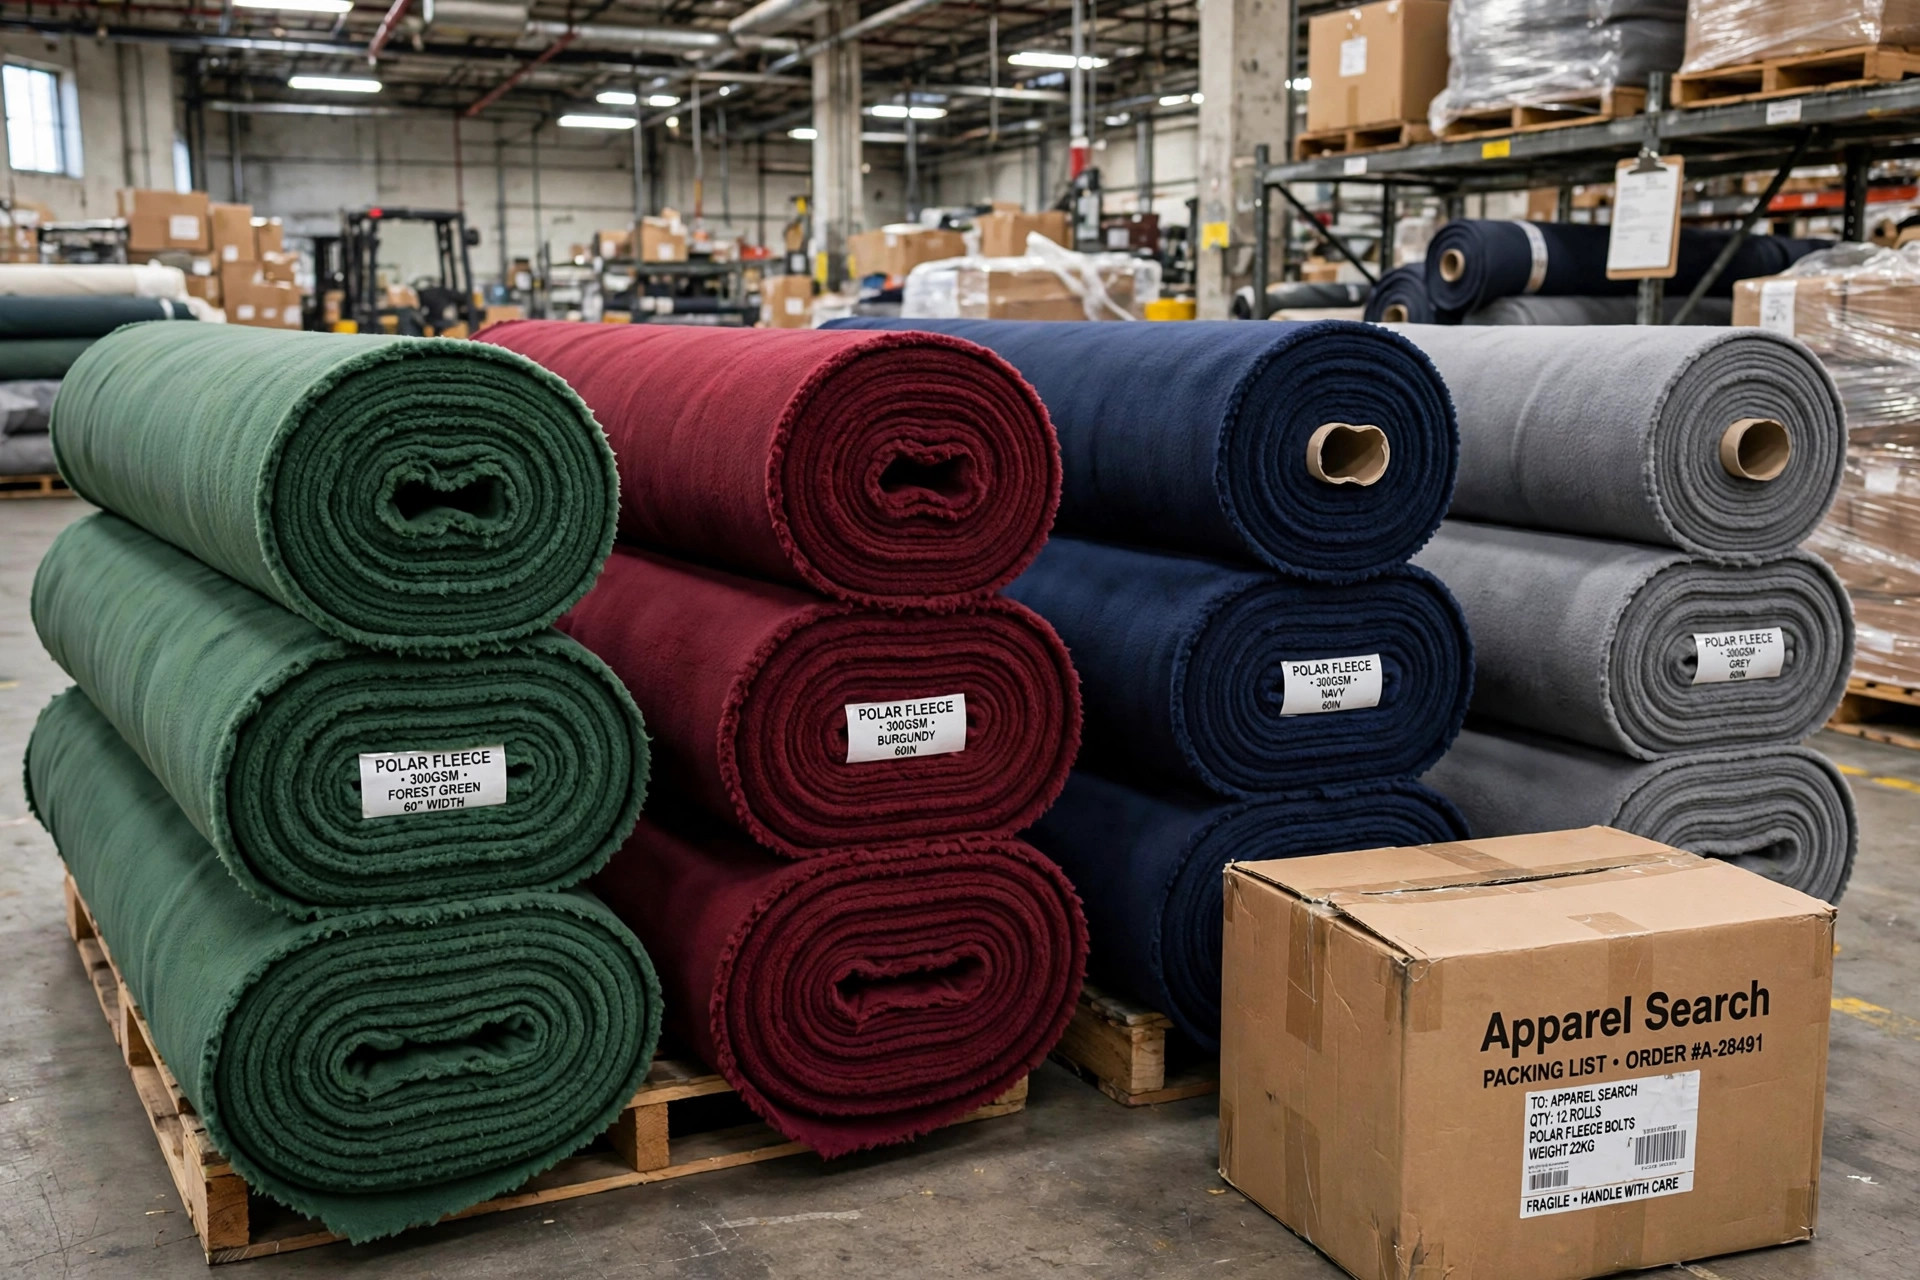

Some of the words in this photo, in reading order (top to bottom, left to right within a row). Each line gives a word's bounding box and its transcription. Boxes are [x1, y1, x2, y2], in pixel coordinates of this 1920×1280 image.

[1705, 636, 1737, 647] POLAR
[1740, 633, 1773, 645] FLEECE
[1726, 647, 1756, 658] 300GSM
[1292, 664, 1330, 676] POLAR
[1332, 660, 1372, 674] FLEECE
[1729, 659, 1751, 669] GREY
[1316, 676, 1351, 687] 300GSM
[1321, 688, 1345, 699] NAVY
[858, 706, 902, 720] POLAR
[905, 701, 954, 716] FLEECE
[1322, 700, 1341, 710] 60IN
[886, 718, 928, 732] 300GSM
[877, 730, 936, 746] BURGUNDY
[894, 745, 917, 756] 60IN
[375, 756, 428, 773] POLAR
[433, 751, 491, 768] FLEECE
[410, 770, 459, 785] 300GSM
[388, 786, 436, 800] FOREST
[439, 782, 481, 795] GREEN
[427, 797, 465, 810] WIDTH
[1480, 996, 1632, 1058] Apparel
[1644, 980, 1770, 1031] Search
[1483, 1060, 1564, 1088] PACKING
[1569, 1055, 1607, 1078] LIST
[1626, 1044, 1687, 1069] ORDER
[1691, 1033, 1764, 1060] #A-28491
[1531, 1096, 1548, 1109] TO:
[1550, 1090, 1596, 1107] APPAREL
[1598, 1084, 1638, 1101] SEARCH
[1530, 1111, 1554, 1127] QTY:
[1557, 1110, 1568, 1123] 12
[1570, 1105, 1602, 1122] ROLLS
[1529, 1126, 1564, 1144] POLAR
[1566, 1121, 1603, 1140] FLEECE
[1605, 1117, 1635, 1134] BOLTS
[1529, 1143, 1569, 1160] WEIGHT
[1569, 1139, 1596, 1155] 22KG
[1526, 1195, 1570, 1213] FRAGILE
[1581, 1187, 1623, 1205] HANDLE
[1624, 1182, 1650, 1198] WITH
[1652, 1176, 1680, 1193] CARE
